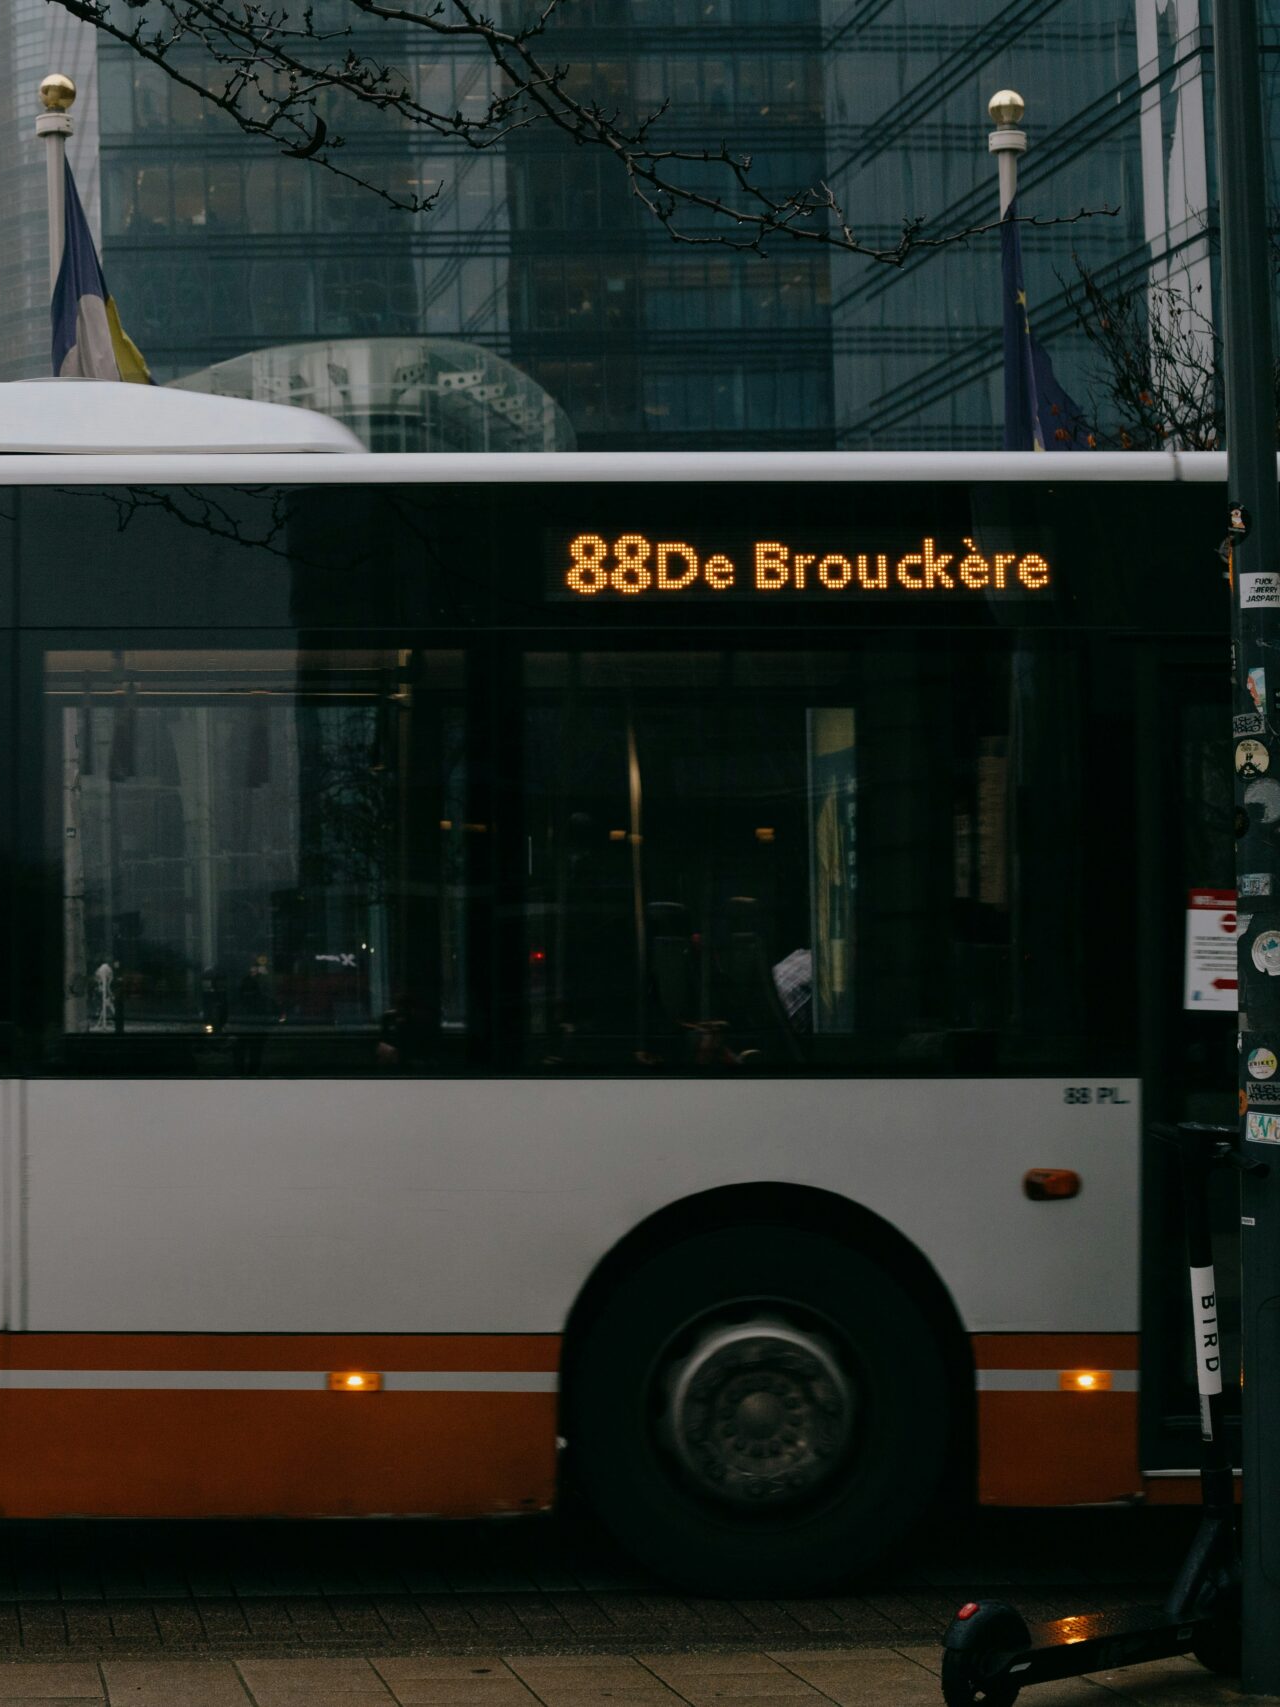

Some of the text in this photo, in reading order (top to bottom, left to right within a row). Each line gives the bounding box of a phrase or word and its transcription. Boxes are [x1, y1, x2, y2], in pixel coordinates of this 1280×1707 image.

[754, 537, 1049, 590] Brouckère
[1254, 577, 1273, 585] FUCK
[1063, 1087, 1092, 1104] 88
[1201, 1294, 1220, 1372] BIRD
